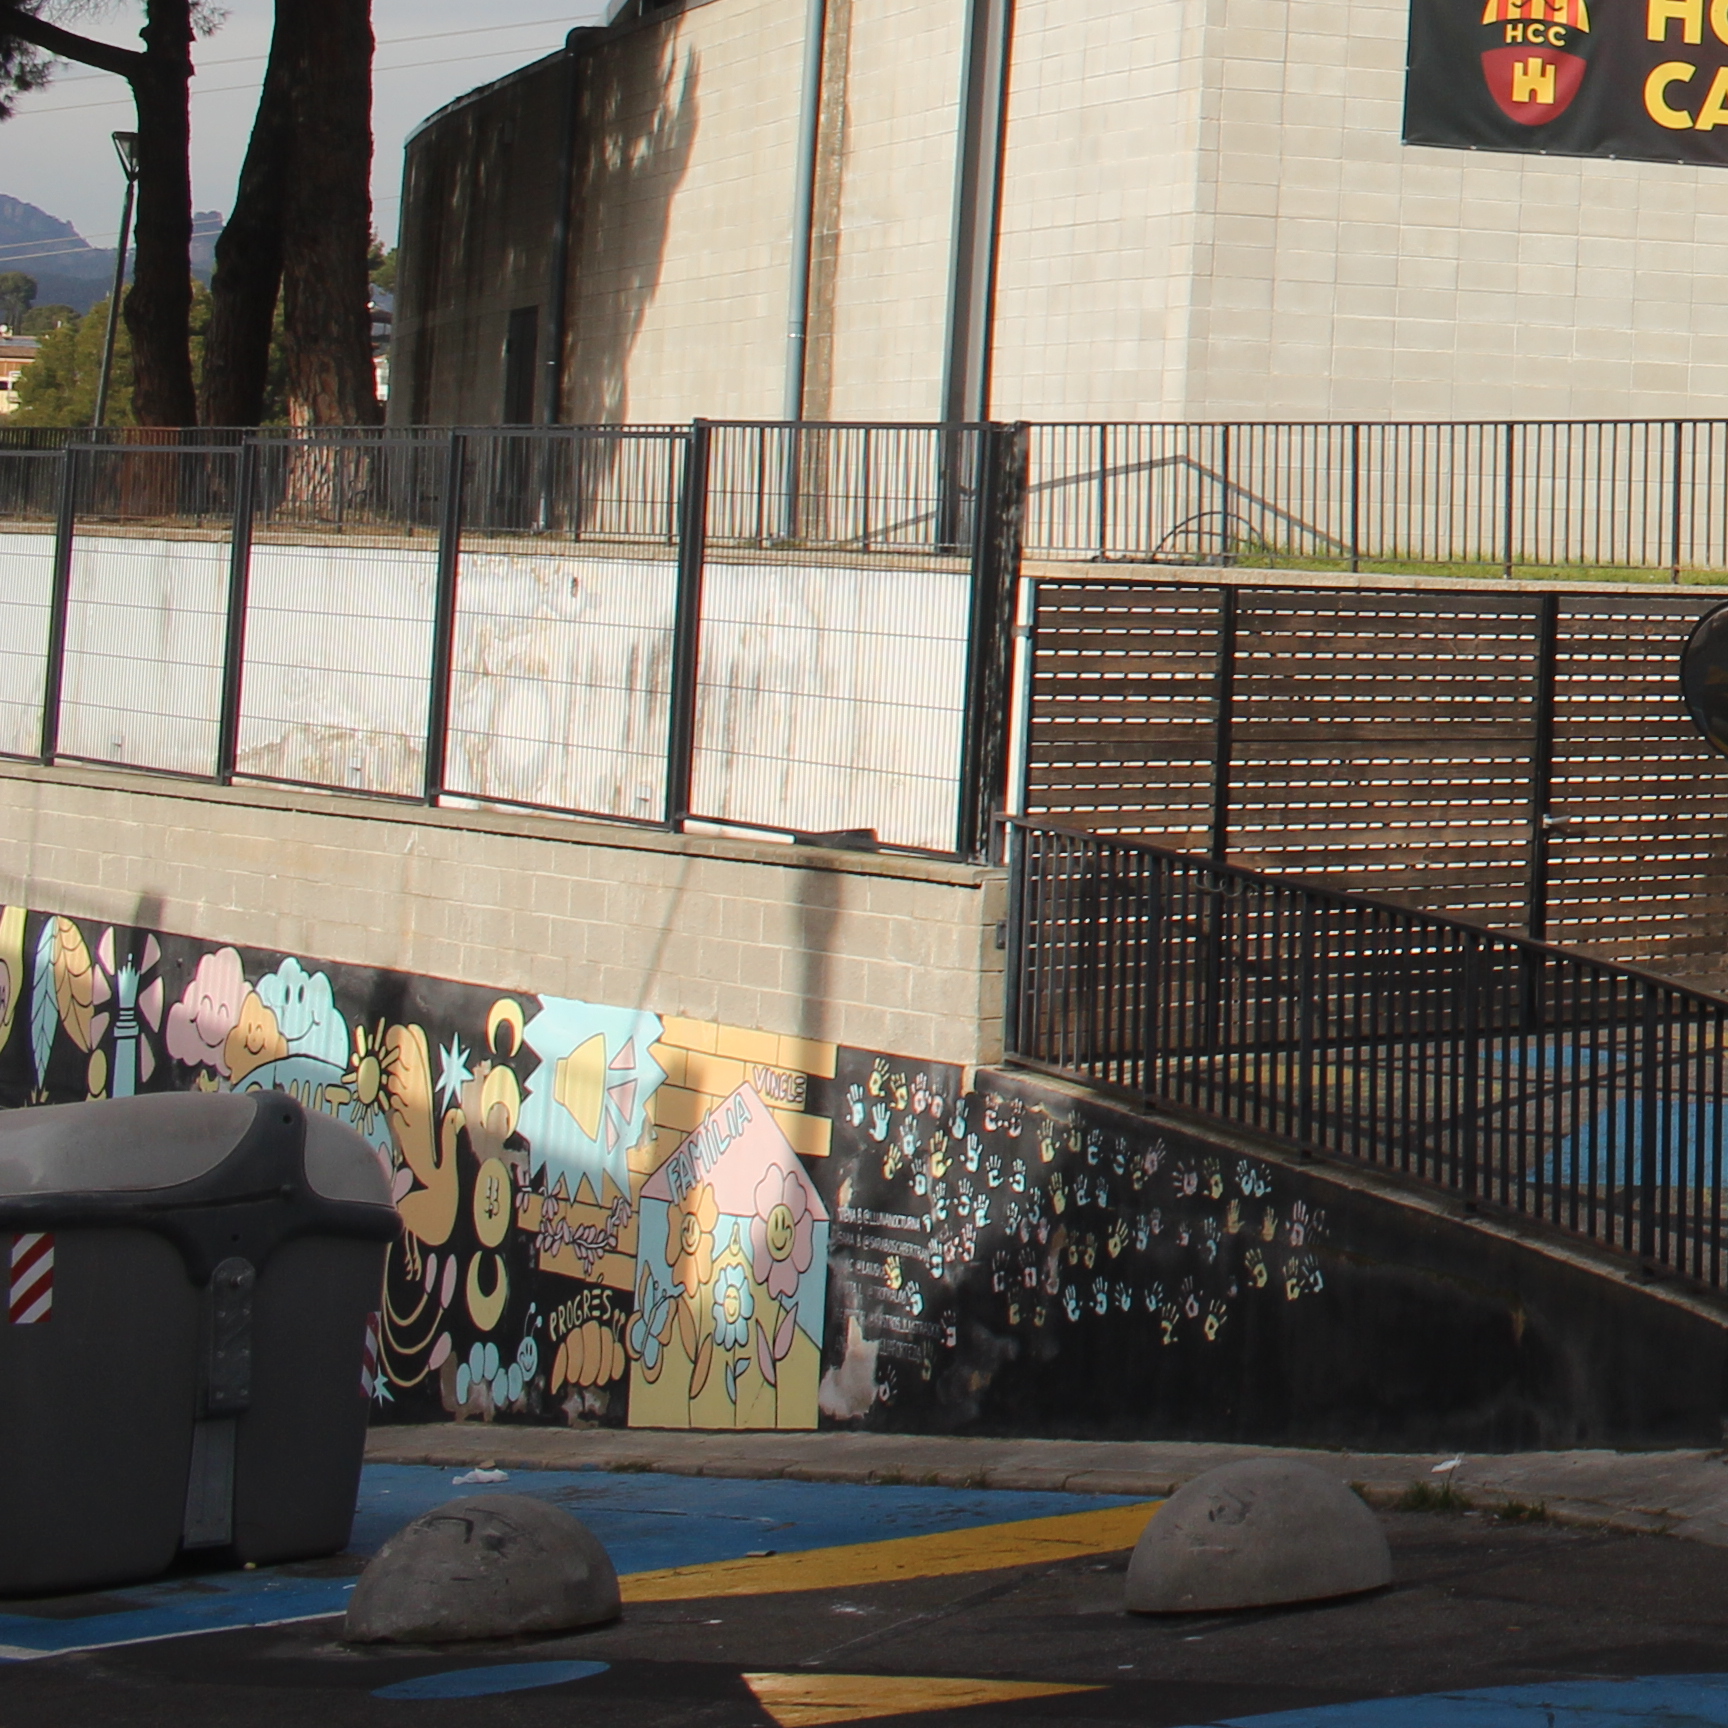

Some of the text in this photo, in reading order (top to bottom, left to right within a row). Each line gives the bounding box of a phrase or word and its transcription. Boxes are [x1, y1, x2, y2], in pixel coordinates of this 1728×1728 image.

[1504, 22, 1567, 48] HCC
[665, 1092, 753, 1206] FAMÍLIA
[549, 1272, 613, 1342] PROGRÉS
